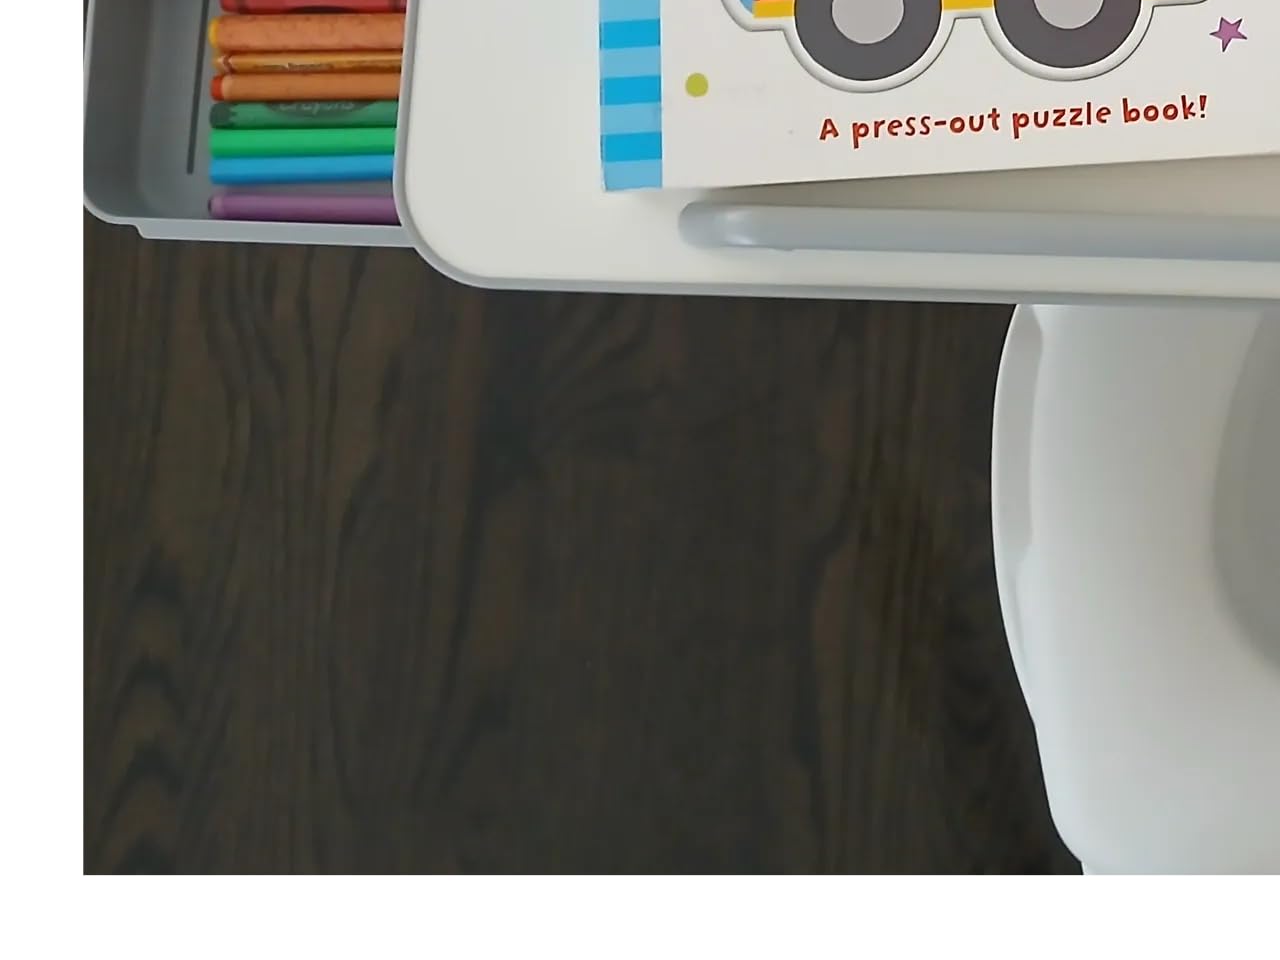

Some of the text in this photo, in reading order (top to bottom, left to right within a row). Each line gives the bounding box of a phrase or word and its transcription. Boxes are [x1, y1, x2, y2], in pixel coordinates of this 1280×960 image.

[819, 94, 1209, 149] A press-out puzzle book!
